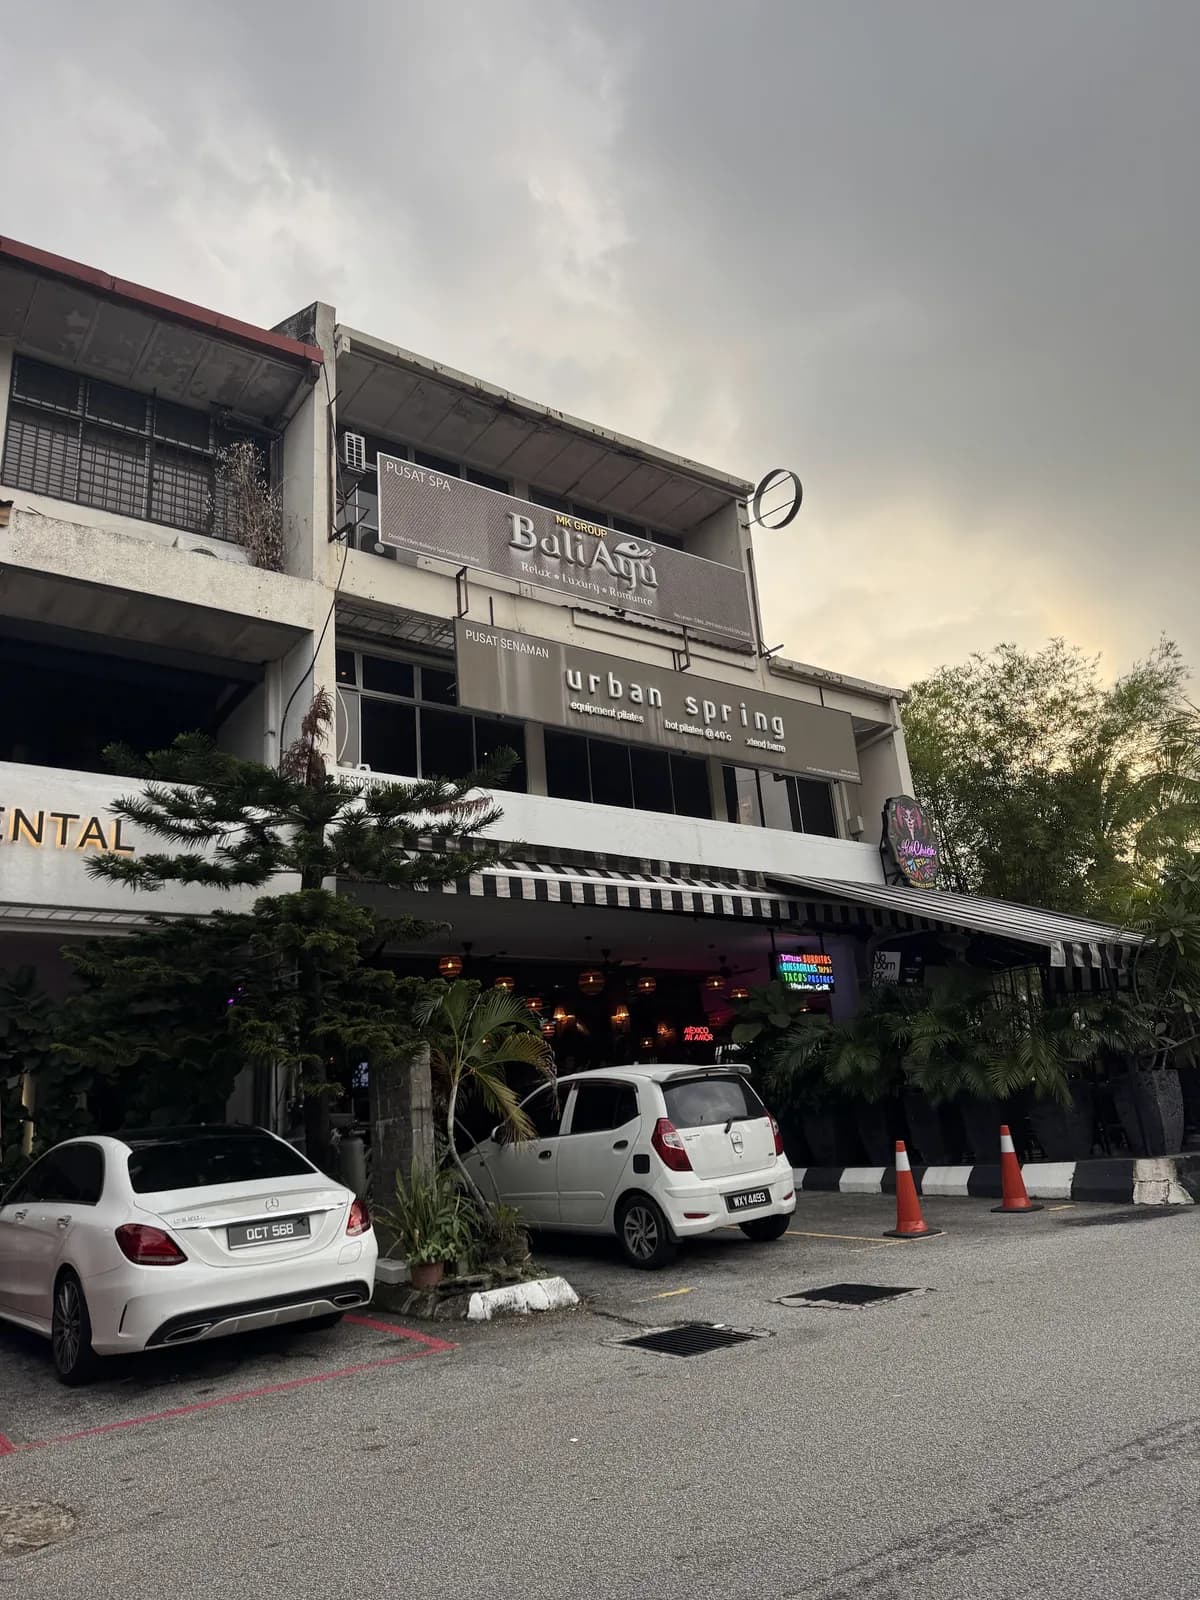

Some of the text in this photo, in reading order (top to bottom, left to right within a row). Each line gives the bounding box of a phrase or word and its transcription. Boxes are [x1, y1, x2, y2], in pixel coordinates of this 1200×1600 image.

[386, 461, 451, 492] PUSAT SPA
[555, 514, 608, 538] MK GROUP
[521, 561, 653, 607] Relax Luxury Romance
[465, 629, 549, 659] PUSAT SENAMAN
[566, 669, 785, 740] urban spring
[570, 701, 616, 718] equipment
[617, 709, 645, 724] pilates
[664, 719, 678, 731] hot
[679, 722, 704, 737] pilates
[0, 806, 135, 851] NTAL
[783, 972, 808, 982] TACOS
[272, 1223, 294, 1236] 568
